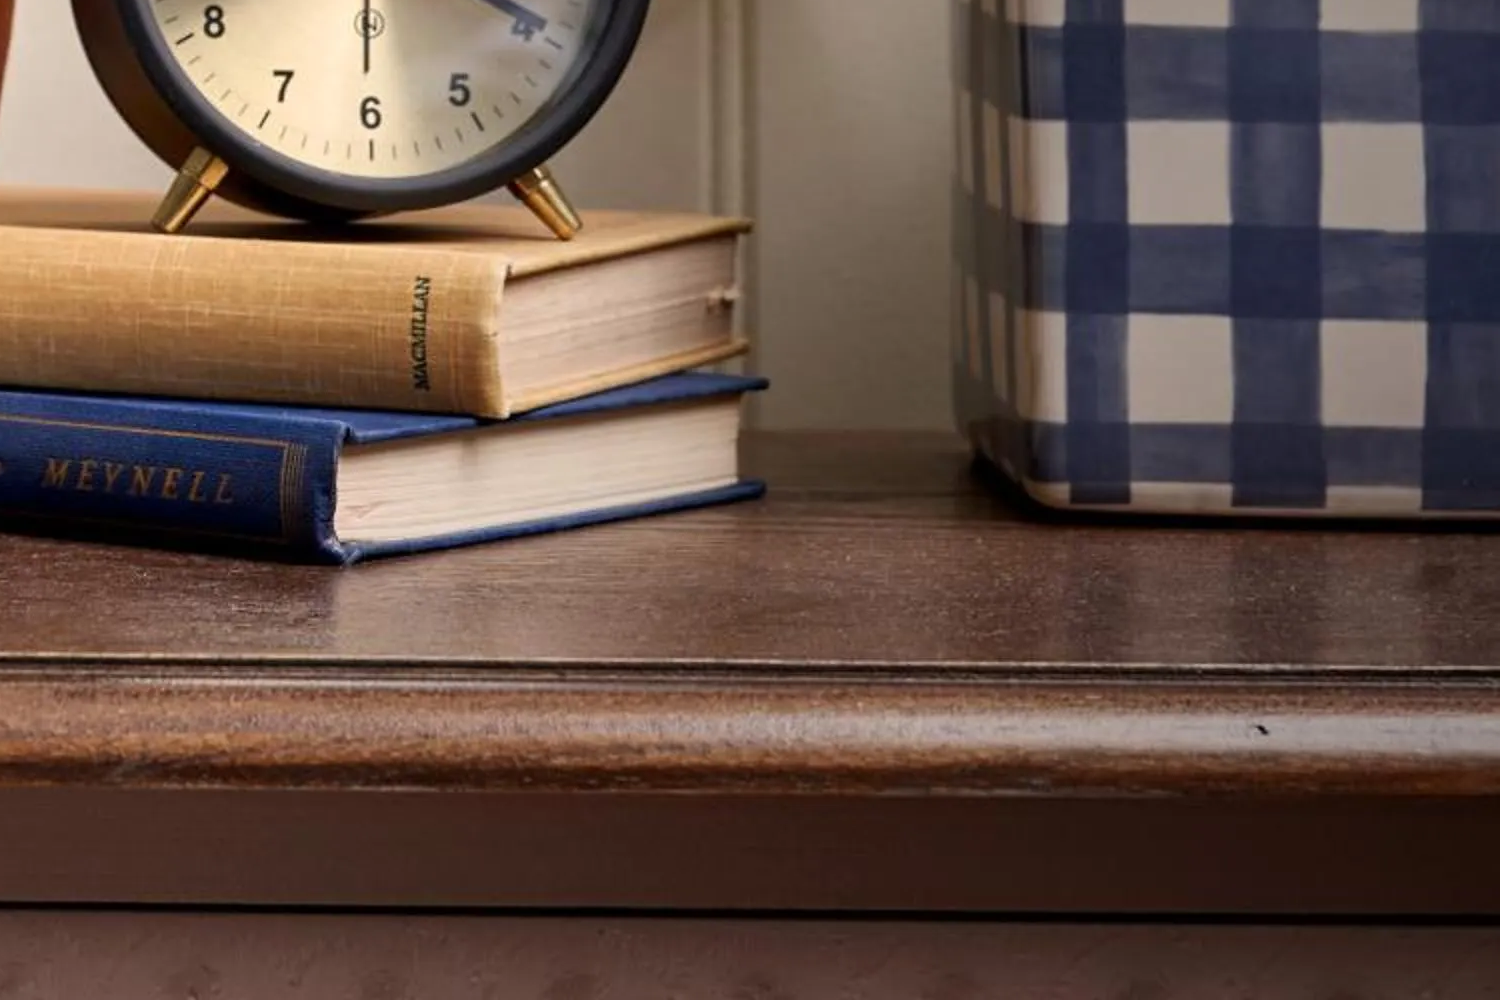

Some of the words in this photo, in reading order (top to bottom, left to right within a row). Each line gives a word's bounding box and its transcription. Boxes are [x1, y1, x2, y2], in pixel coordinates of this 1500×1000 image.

[203, 5, 226, 39] 8
[272, 70, 295, 103] 7
[449, 73, 471, 107] 5
[359, 96, 382, 130] 6
[411, 276, 432, 392] MACMILLAN
[41, 457, 235, 504] MEYNELL
